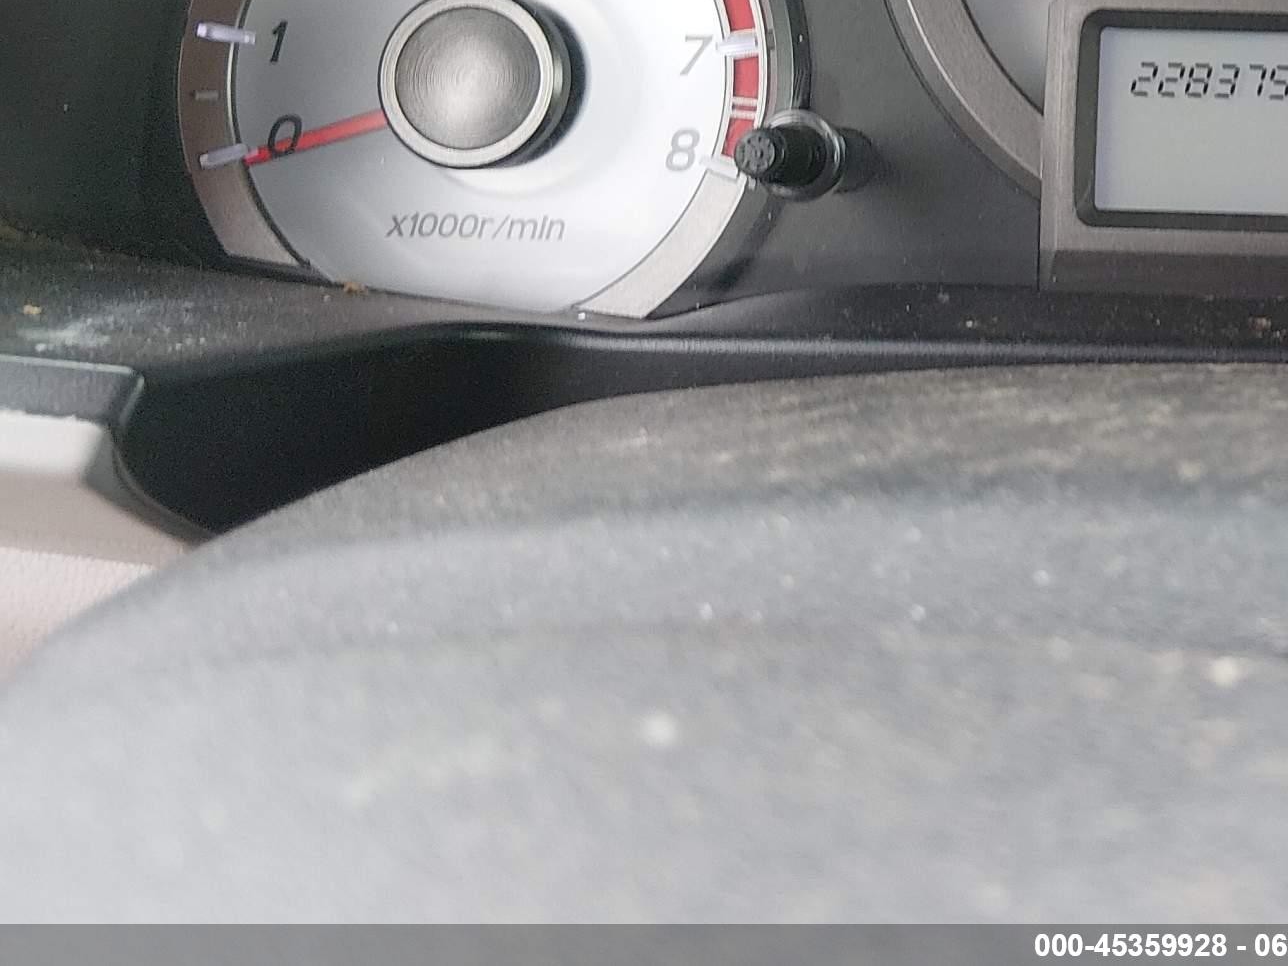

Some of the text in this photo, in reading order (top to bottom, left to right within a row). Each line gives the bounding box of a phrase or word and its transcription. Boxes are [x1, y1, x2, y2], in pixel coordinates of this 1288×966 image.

[270, 21, 288, 62] 1
[679, 36, 712, 75] 7
[267, 115, 302, 159] 0
[665, 130, 700, 171] 8
